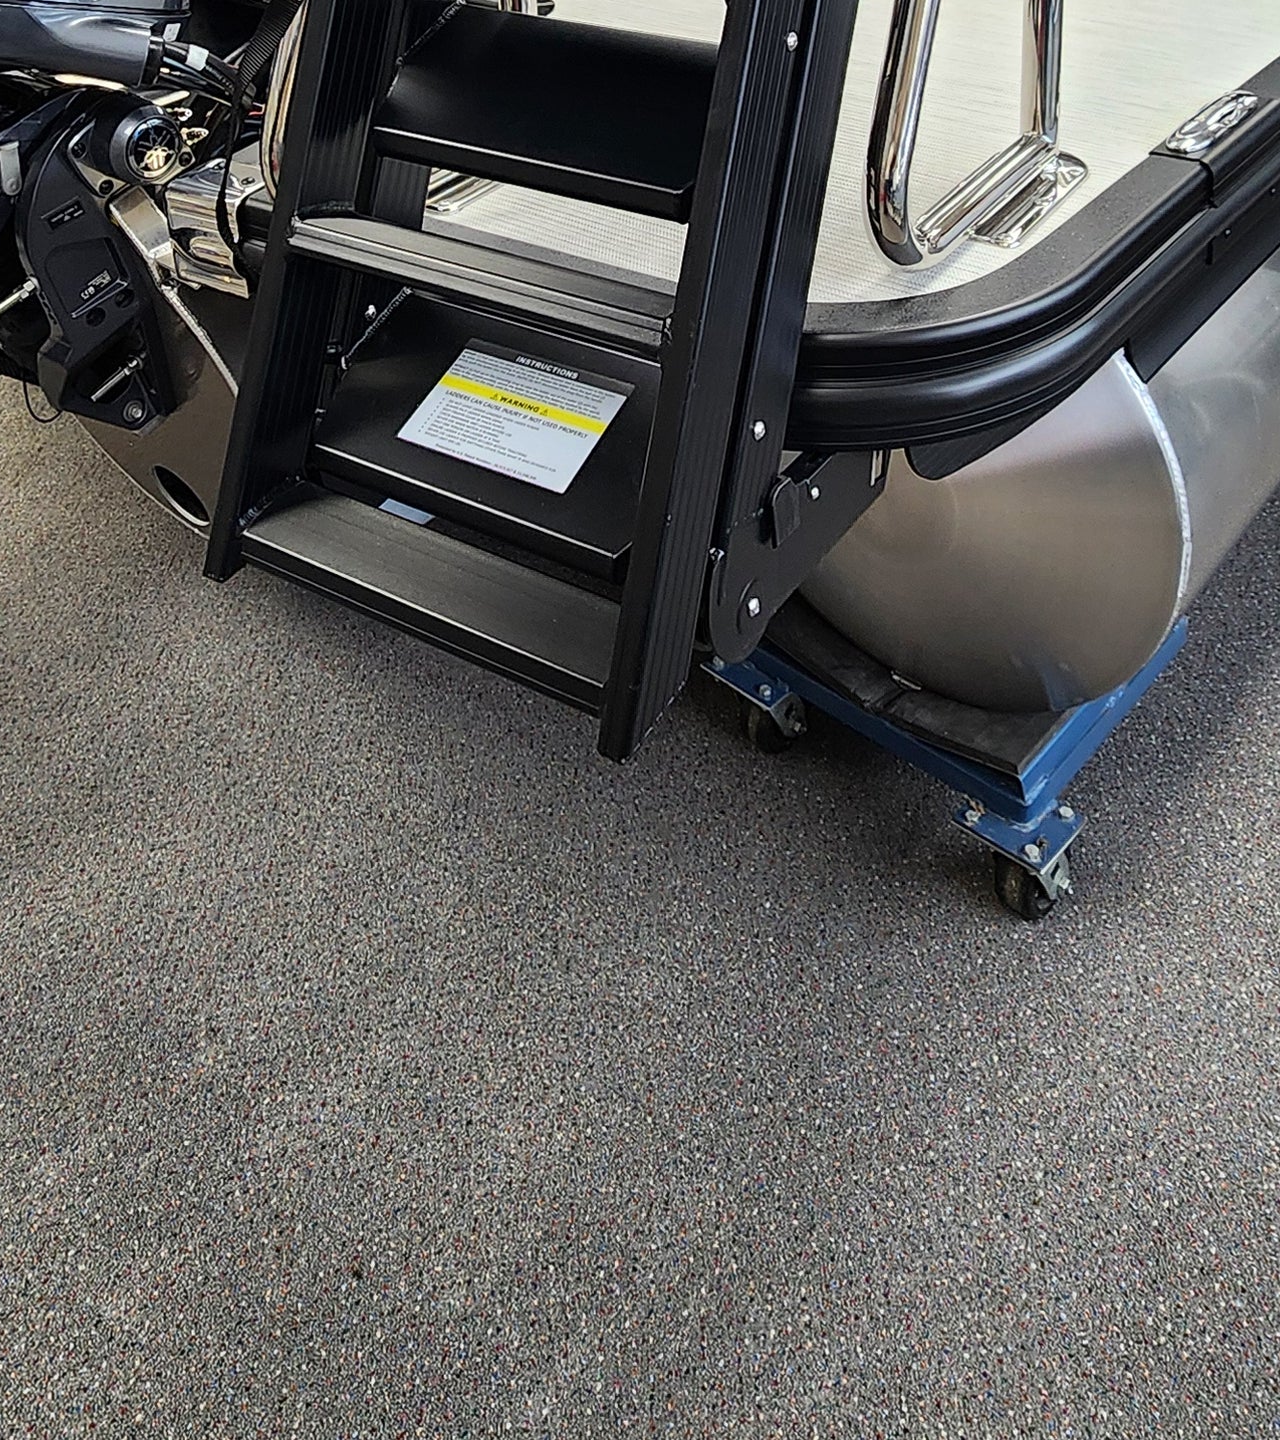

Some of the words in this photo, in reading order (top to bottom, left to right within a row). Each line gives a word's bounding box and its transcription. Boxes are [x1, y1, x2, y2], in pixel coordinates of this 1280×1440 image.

[515, 355, 580, 380] INSTRUCTIONS
[499, 395, 540, 414] WARNING
[470, 397, 483, 405] CAN
[483, 400, 502, 411] CAUSE
[529, 415, 542, 424] NOT
[542, 419, 558, 429] USED
[558, 423, 588, 439] PROPERLY
